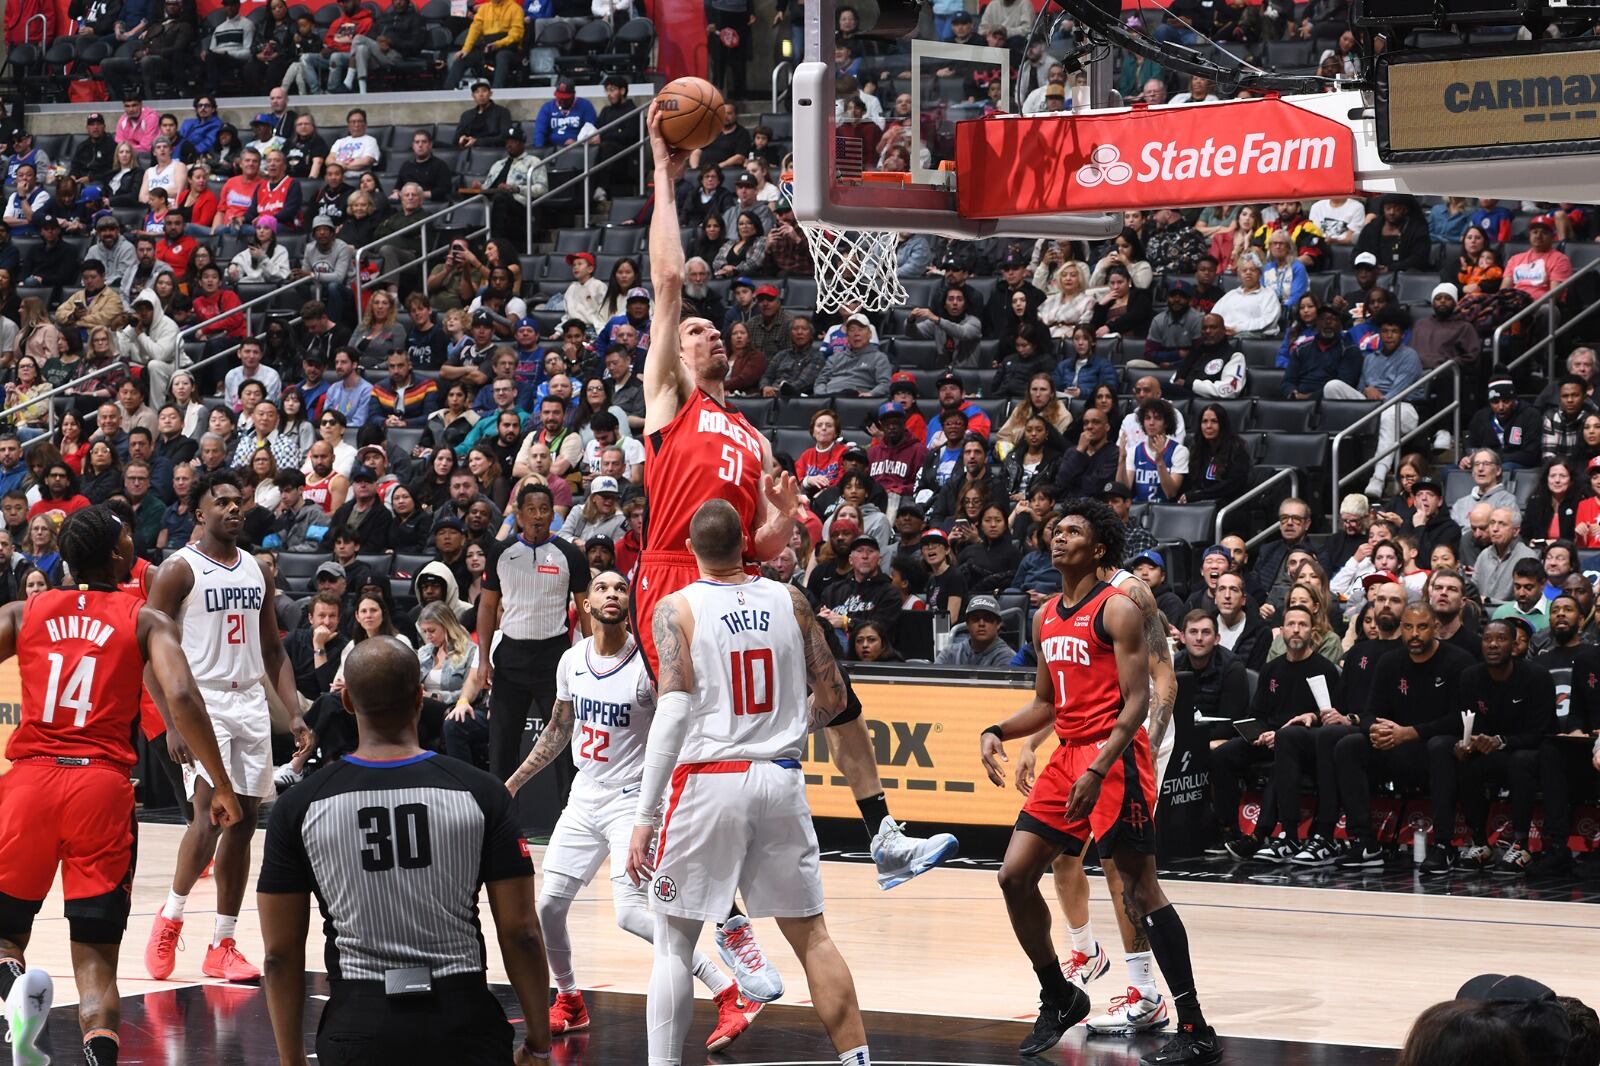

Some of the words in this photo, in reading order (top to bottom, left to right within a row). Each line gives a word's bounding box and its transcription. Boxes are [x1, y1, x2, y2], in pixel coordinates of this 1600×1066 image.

[1444, 74, 1600, 113] CARma
[697, 409, 761, 462] ROCKETS
[718, 443, 743, 486] 51
[1135, 469, 1160, 485] CLIPP
[204, 587, 262, 612] CLIPPERS
[45, 615, 115, 647] HINTON
[227, 614, 246, 645] 21
[720, 610, 770, 635] THEIS
[1041, 635, 1090, 666] OCKETS
[42, 652, 97, 728] 14
[730, 648, 773, 715] 10
[1057, 670, 1066, 707] 1
[579, 725, 610, 763] 22
[1163, 771, 1209, 794] STARLUX
[1170, 790, 1203, 806] AIRLINES
[357, 803, 432, 872] 30
